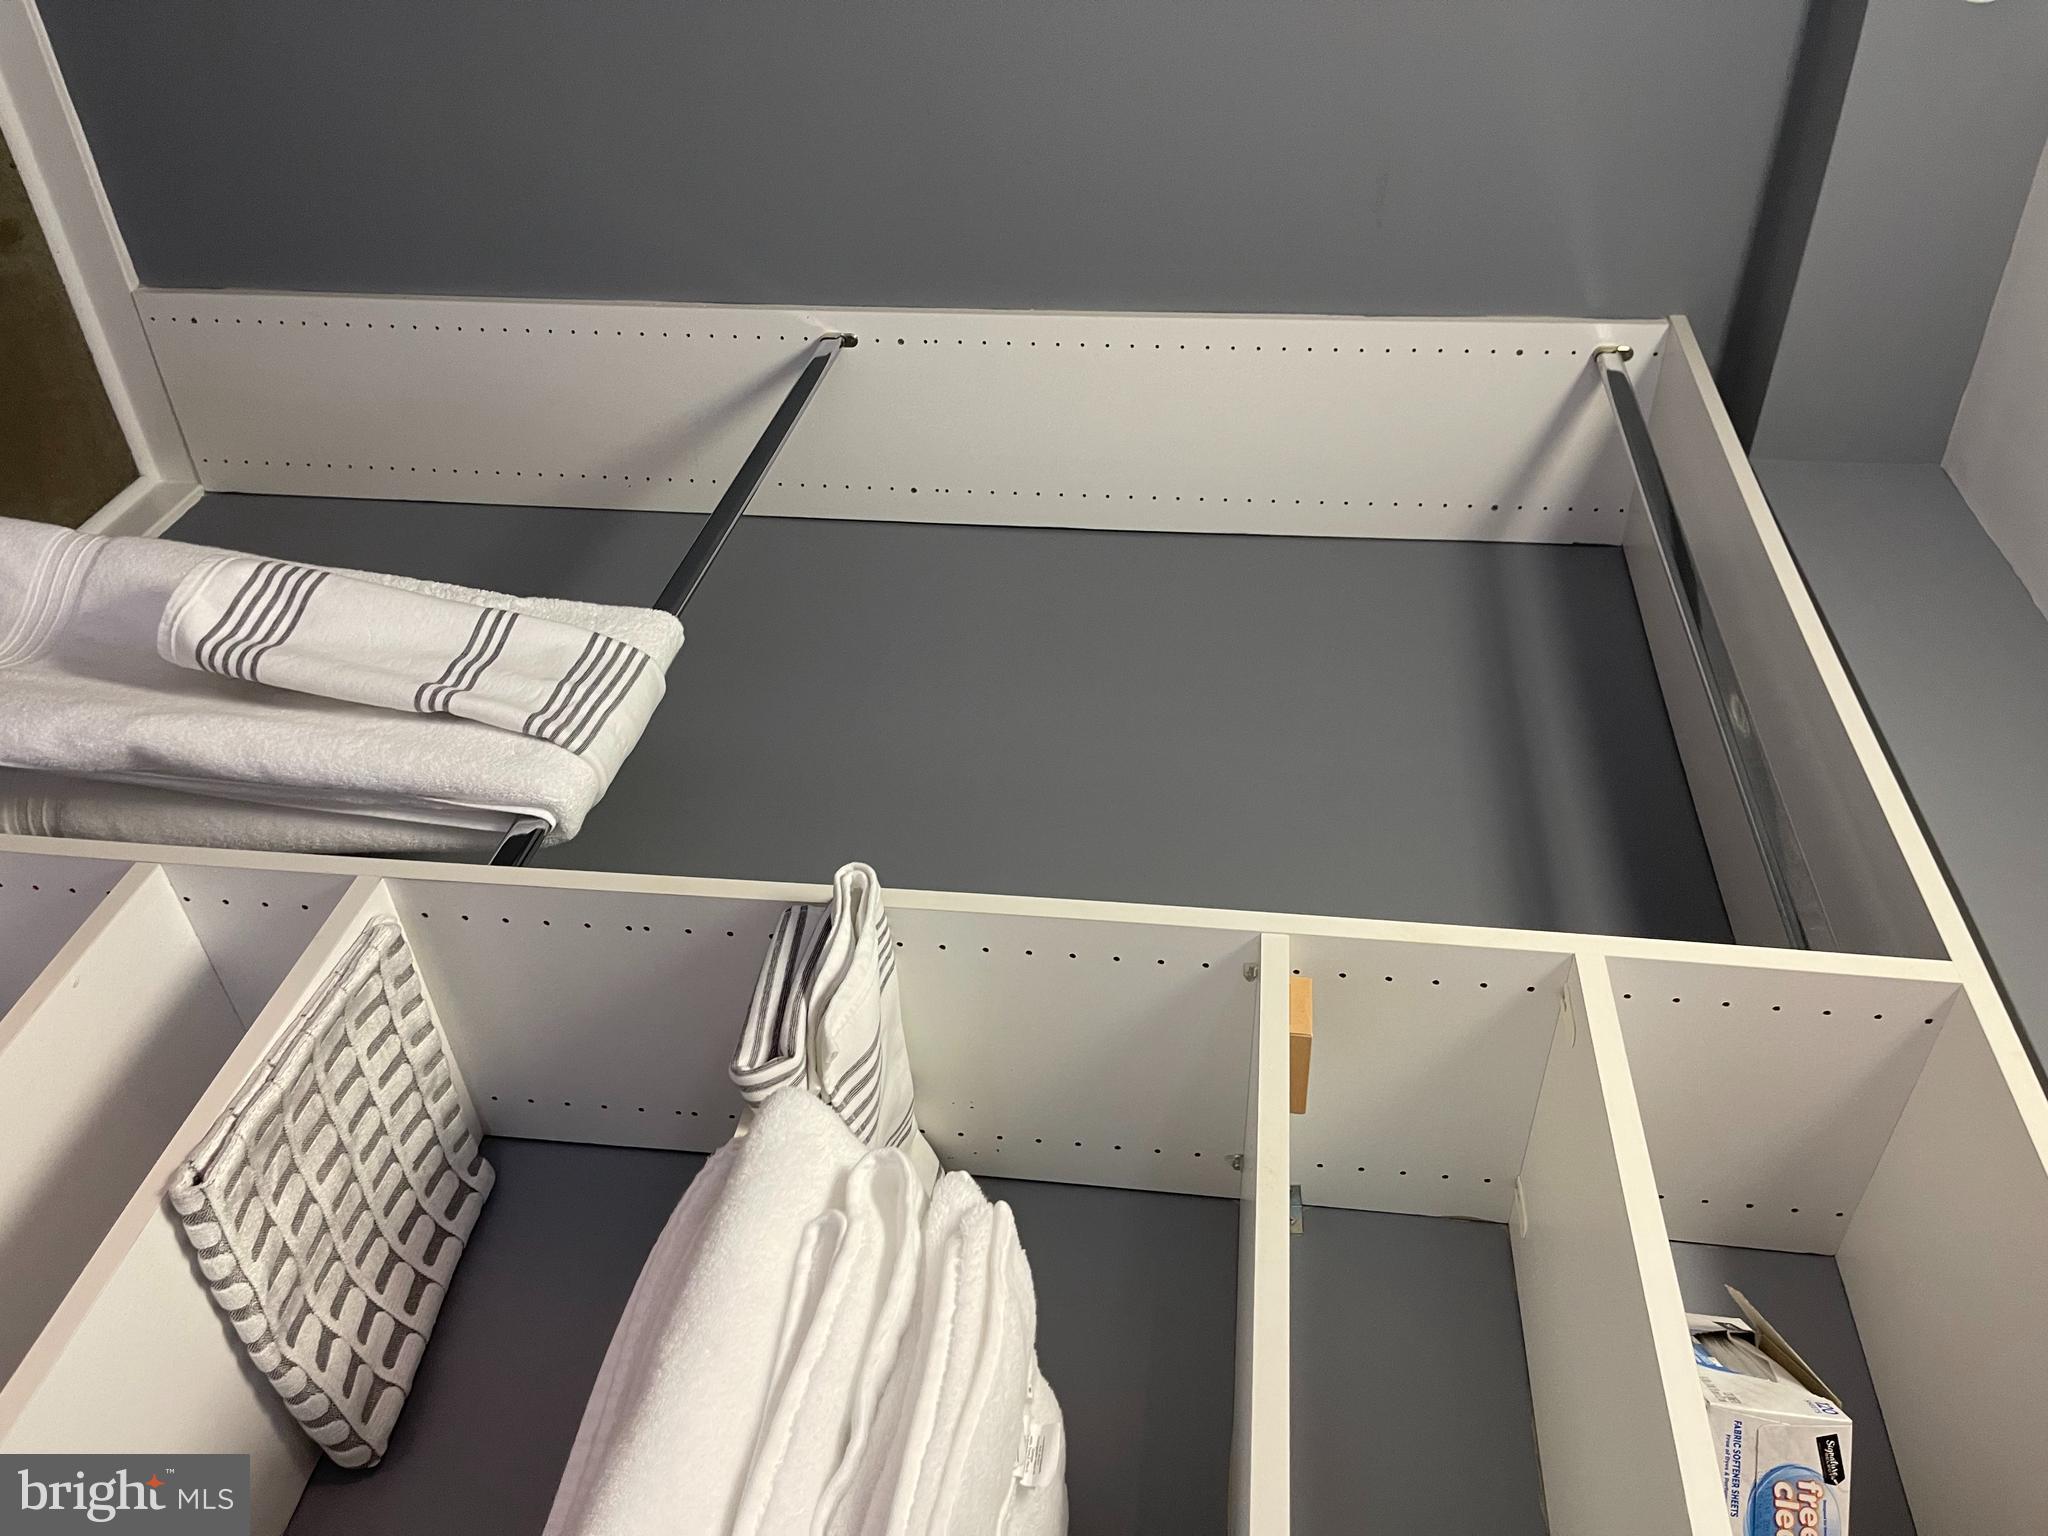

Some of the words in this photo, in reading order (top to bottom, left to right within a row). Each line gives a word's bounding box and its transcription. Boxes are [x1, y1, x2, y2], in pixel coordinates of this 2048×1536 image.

[1733, 1420, 1742, 1449] FABRIC
[1731, 1449, 1741, 1488] SOFTENER
[1824, 1439, 1839, 1478] Signature
[1730, 1489, 1740, 1518] SHEETS
